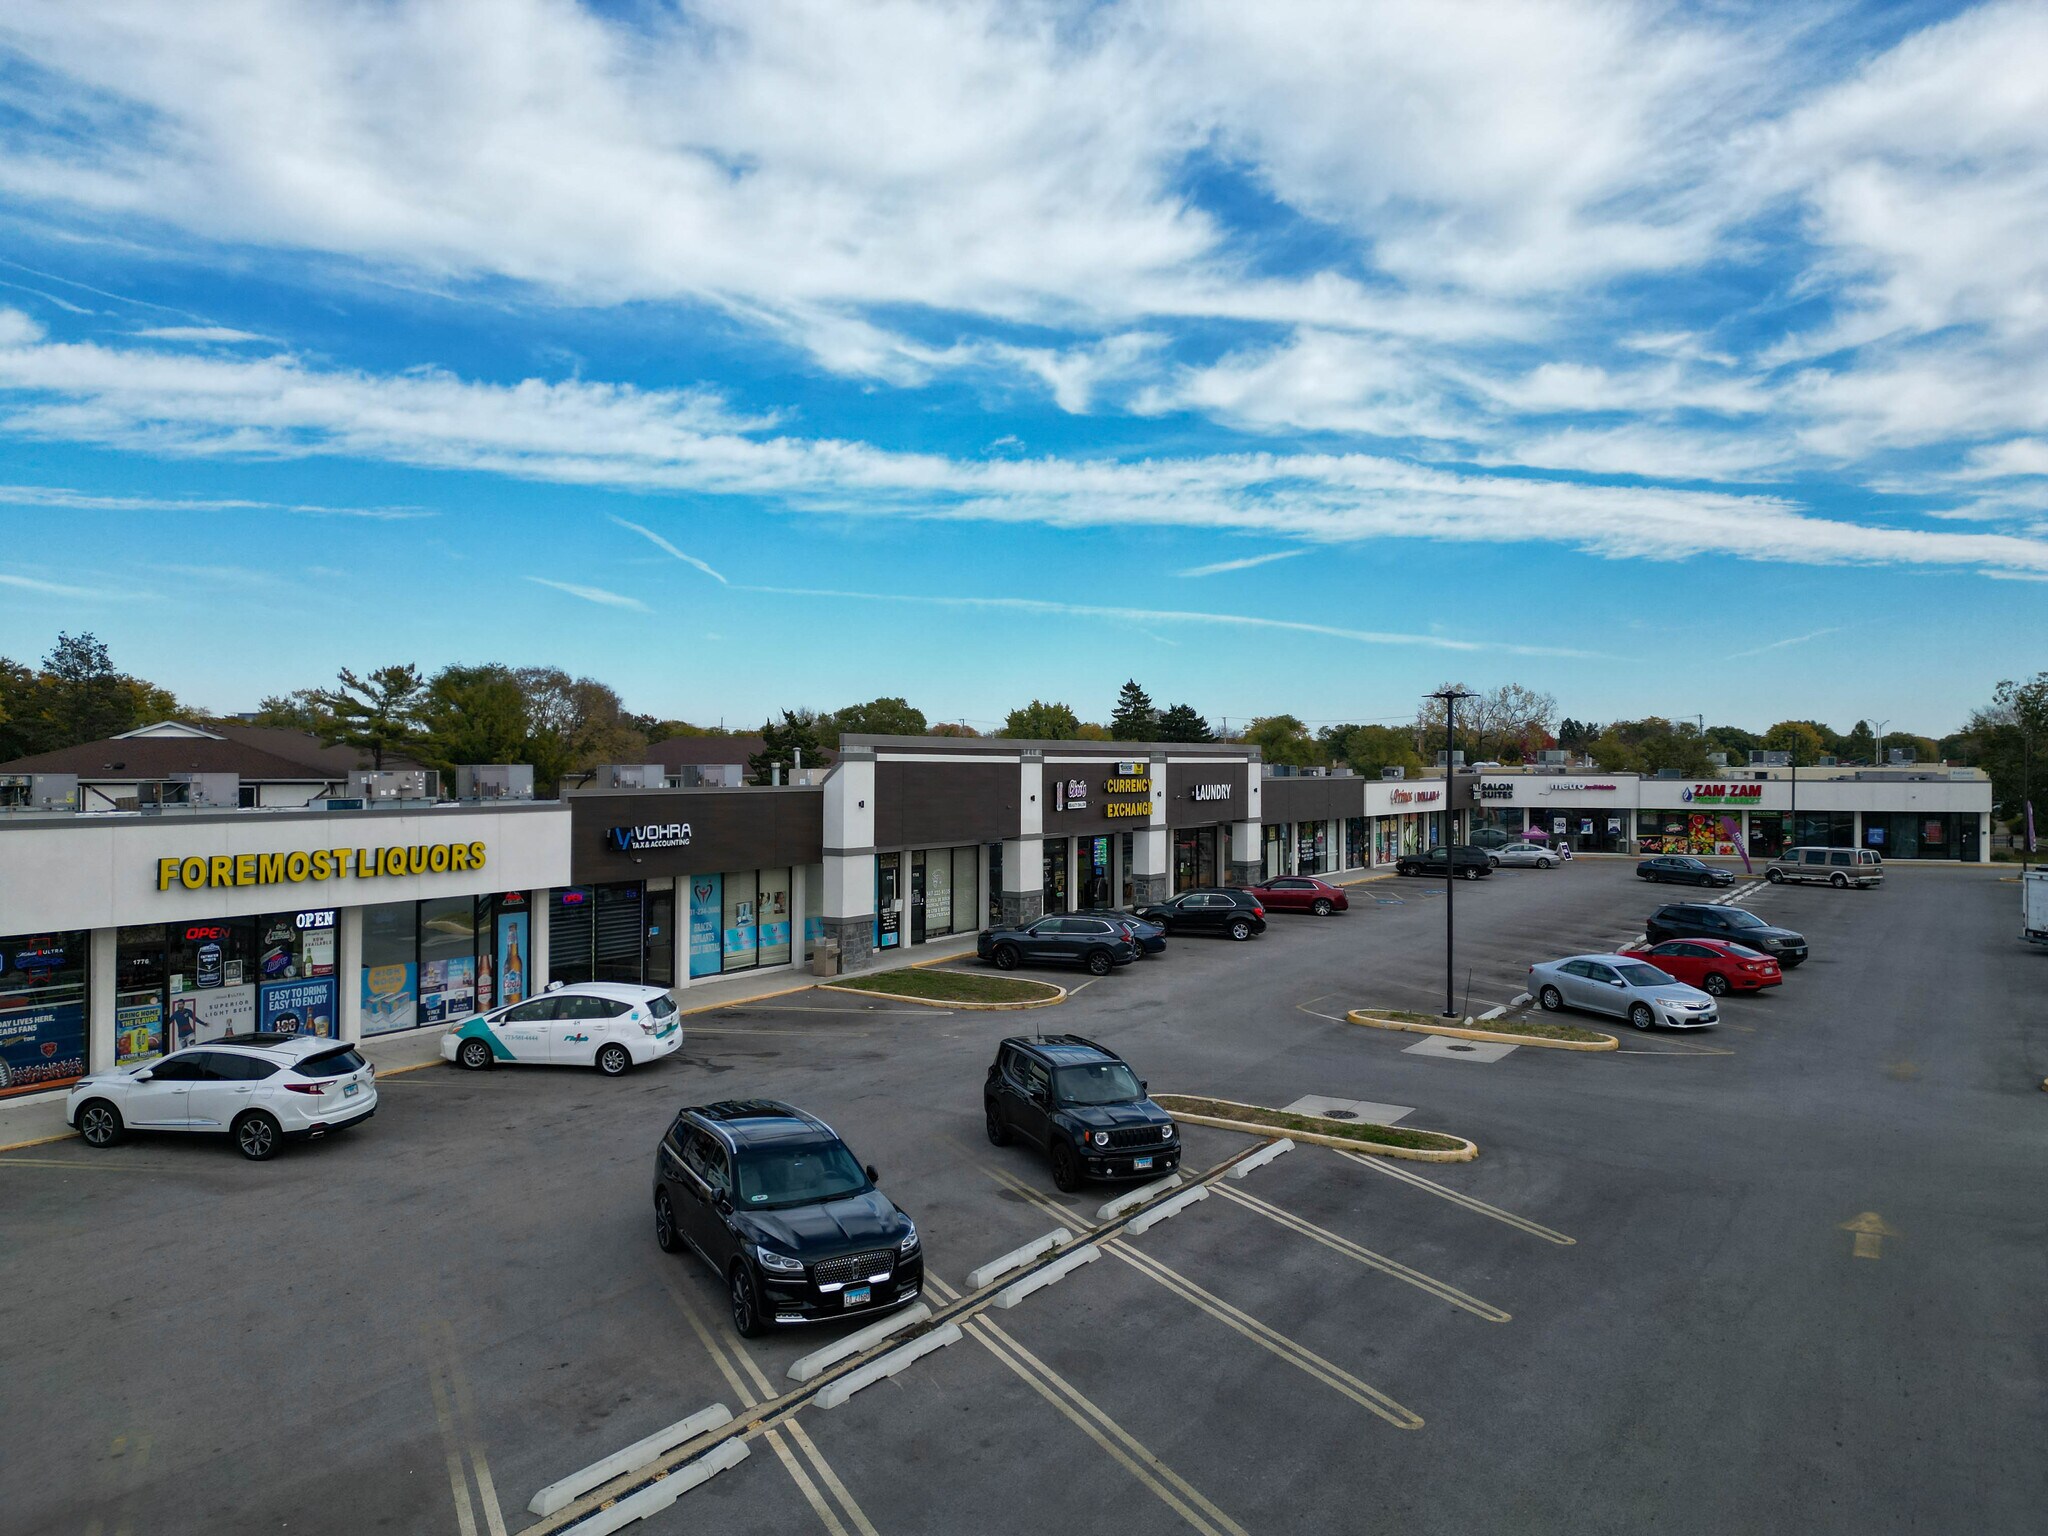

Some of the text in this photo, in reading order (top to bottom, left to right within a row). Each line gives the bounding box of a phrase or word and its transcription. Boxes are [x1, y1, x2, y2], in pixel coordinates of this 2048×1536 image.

[1107, 779, 1152, 793] CURRENCY
[1481, 783, 1513, 791] SALON
[1551, 782, 1585, 790] metro
[1694, 785, 1762, 797] ZAM ZAM
[1195, 784, 1231, 800] LAUNDRY
[1482, 791, 1513, 799] SUITES
[1107, 802, 1153, 818] EXCHANGE
[635, 823, 692, 840] VOHRA
[632, 841, 645, 849] TAX
[651, 838, 690, 848] ACCOUNTING
[158, 841, 487, 891] FOREMOST LIQUORS
[296, 911, 334, 928] OPEN
[186, 928, 231, 939] OPEN
[269, 985, 327, 1001] EASY TO DRINK
[209, 1000, 249, 1010] SUPERIOR
[269, 994, 327, 1011] EASY TO ENJOY
[119, 1011, 140, 1019] BRING
[205, 1009, 229, 1018] LIGHT
[13, 1018, 33, 1026] LIVES
[134, 1017, 158, 1026] FLAVOR
[18, 1025, 37, 1033] FANS
[120, 1052, 139, 1060] STORE
